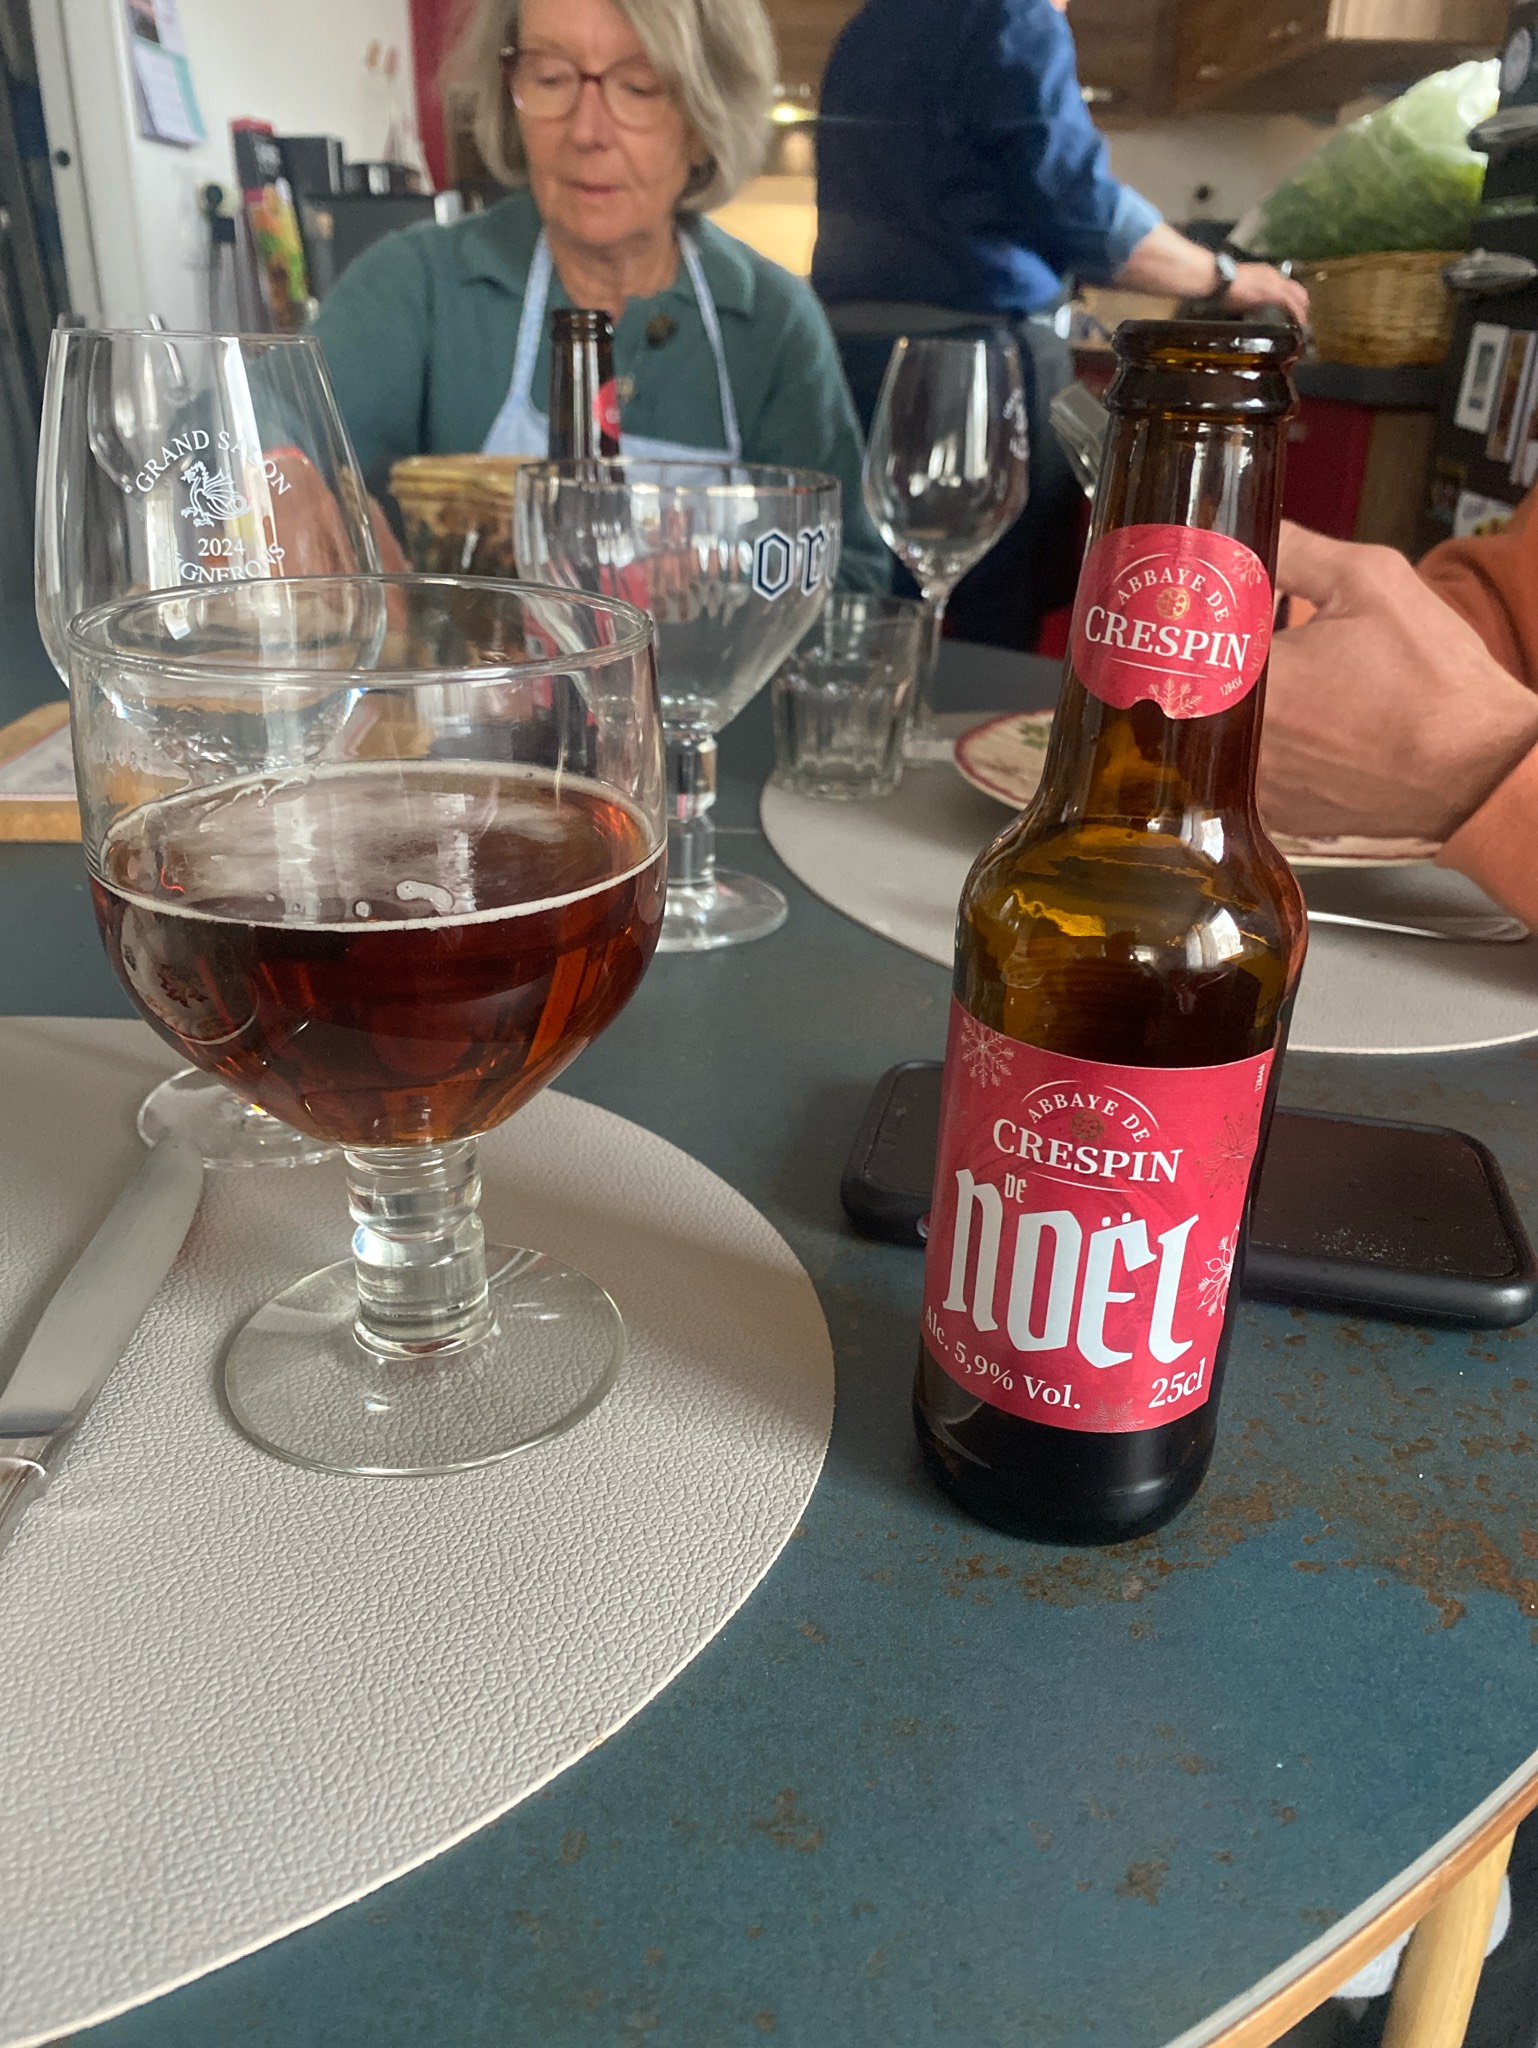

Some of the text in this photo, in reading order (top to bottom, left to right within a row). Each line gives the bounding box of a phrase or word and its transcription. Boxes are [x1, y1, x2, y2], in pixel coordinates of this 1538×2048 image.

[136, 430, 292, 496] GRAND SAON
[174, 542, 286, 583] IGNERONS
[198, 538, 245, 557] 2024
[1117, 567, 1230, 622] ABBAYE DE
[1085, 606, 1251, 671] CRESPIN
[1028, 1093, 1151, 1143] ABBAYE DE
[993, 1118, 1184, 1183] CRESPIN
[1004, 1173, 1027, 1203] DE
[925, 1305, 1081, 1410] Alc. 5,9% Vol.
[1148, 1356, 1206, 1408] 25cl
